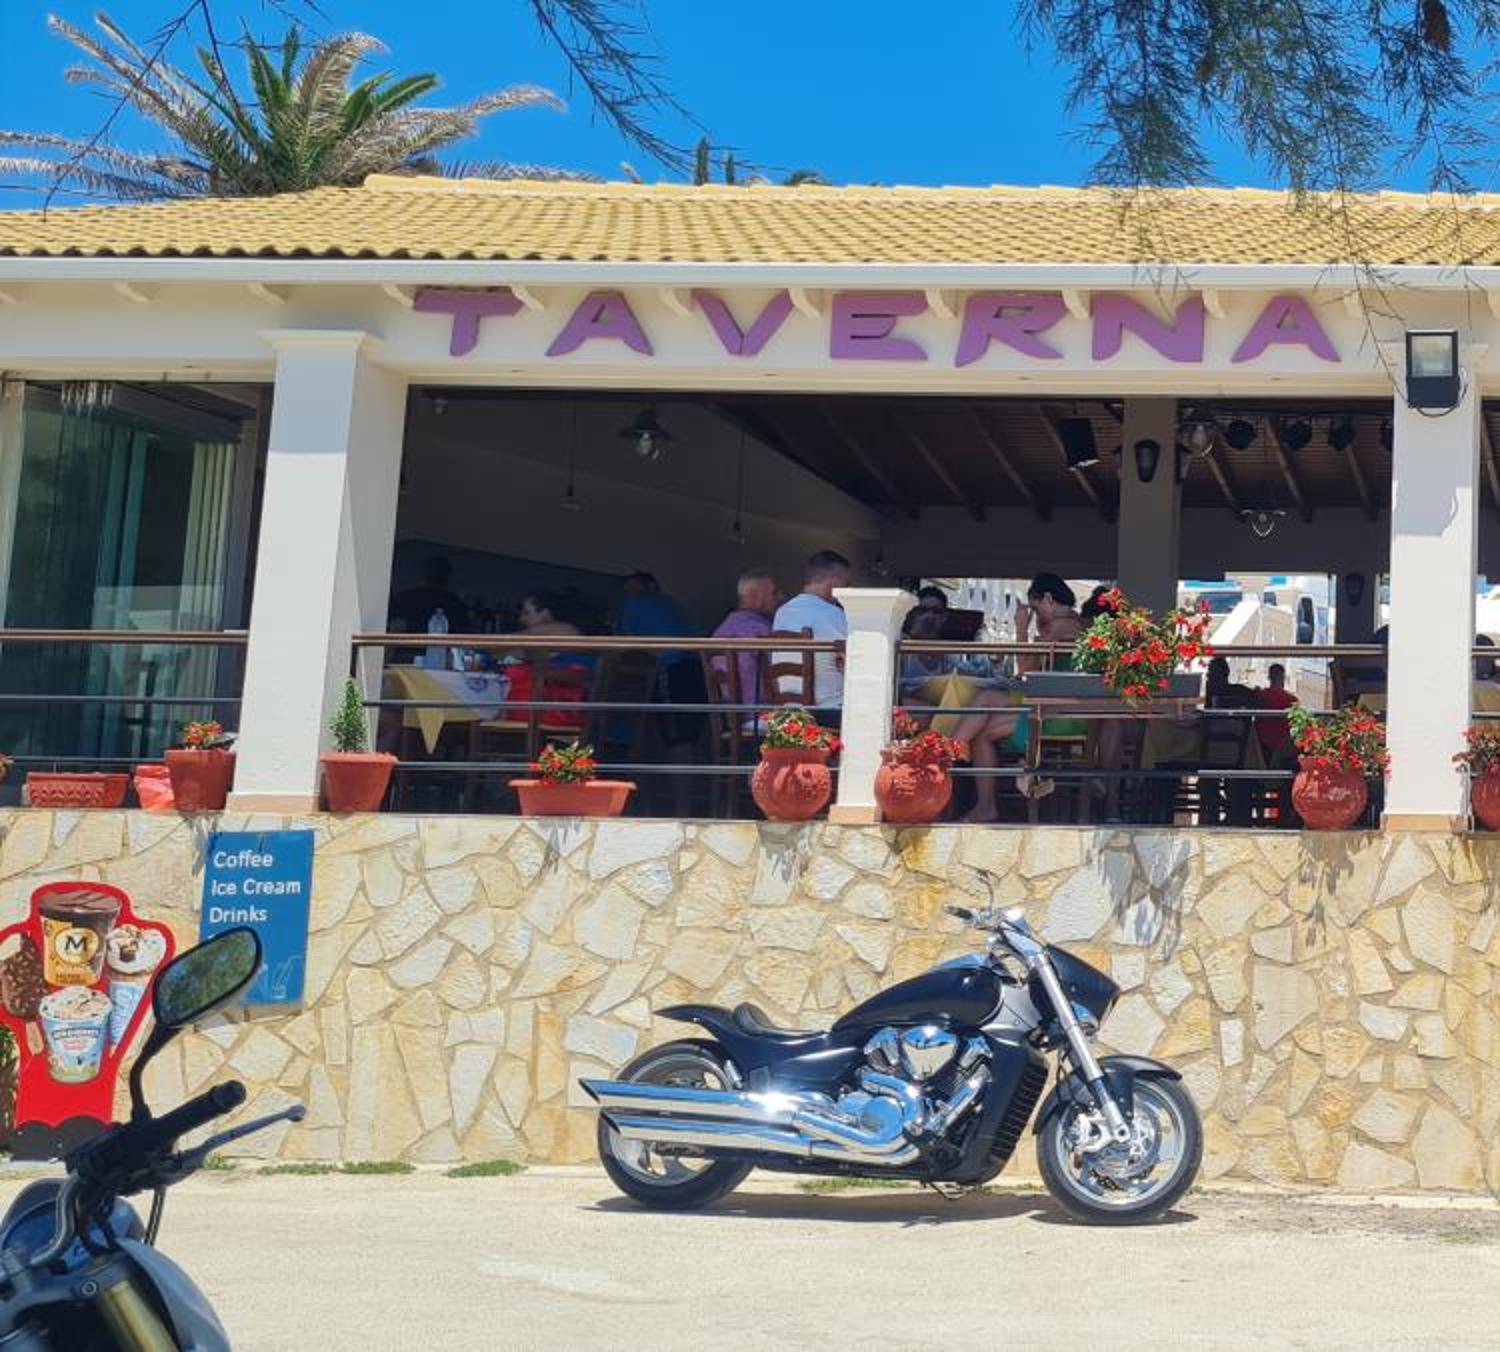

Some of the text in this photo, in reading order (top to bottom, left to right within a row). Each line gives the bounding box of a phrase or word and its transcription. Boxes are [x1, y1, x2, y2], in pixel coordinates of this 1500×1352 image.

[413, 287, 1340, 367] TAVERNA
[214, 850, 273, 868] Coffee
[212, 878, 301, 896] Ice Cream
[209, 904, 268, 923] Drinks
